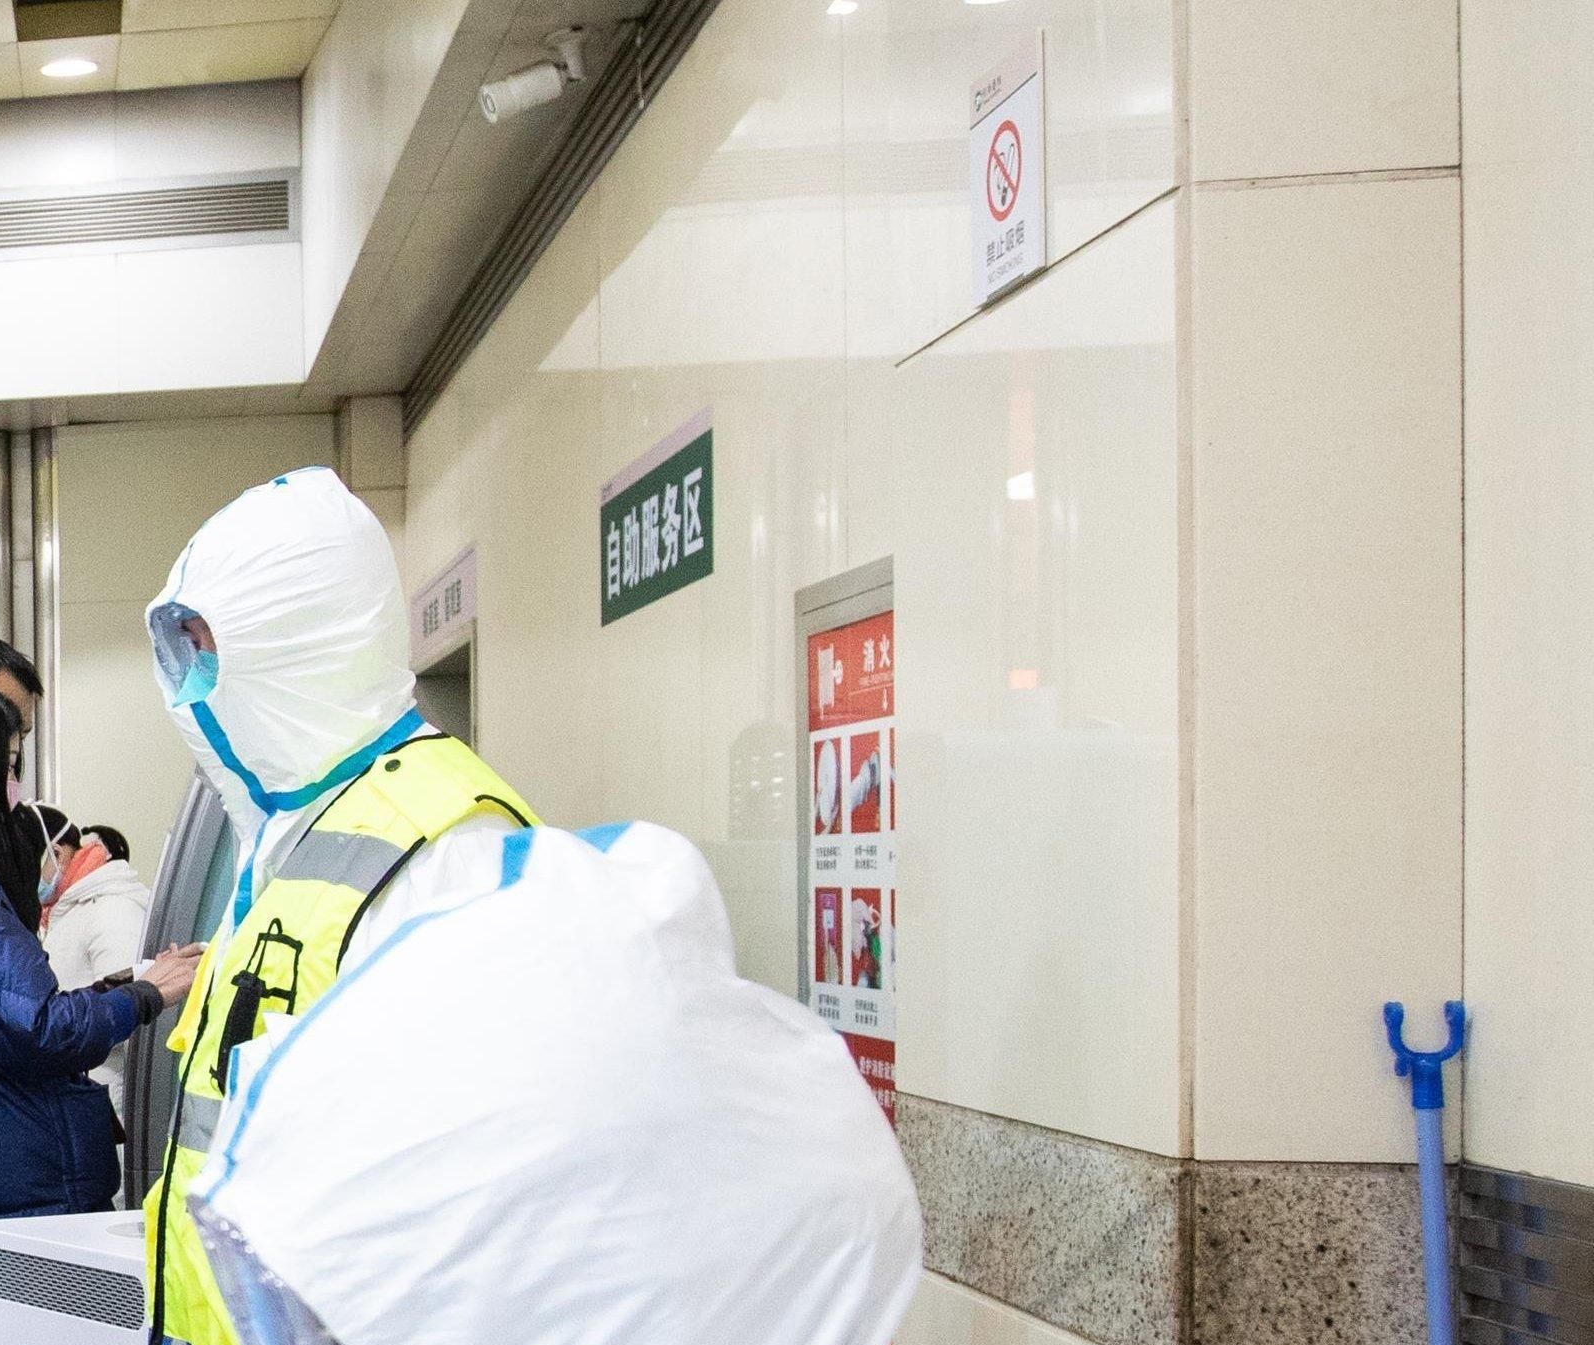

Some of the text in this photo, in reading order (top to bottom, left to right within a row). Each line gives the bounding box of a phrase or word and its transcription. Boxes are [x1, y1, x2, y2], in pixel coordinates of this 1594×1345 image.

[607, 467, 704, 600] 自助服务区
